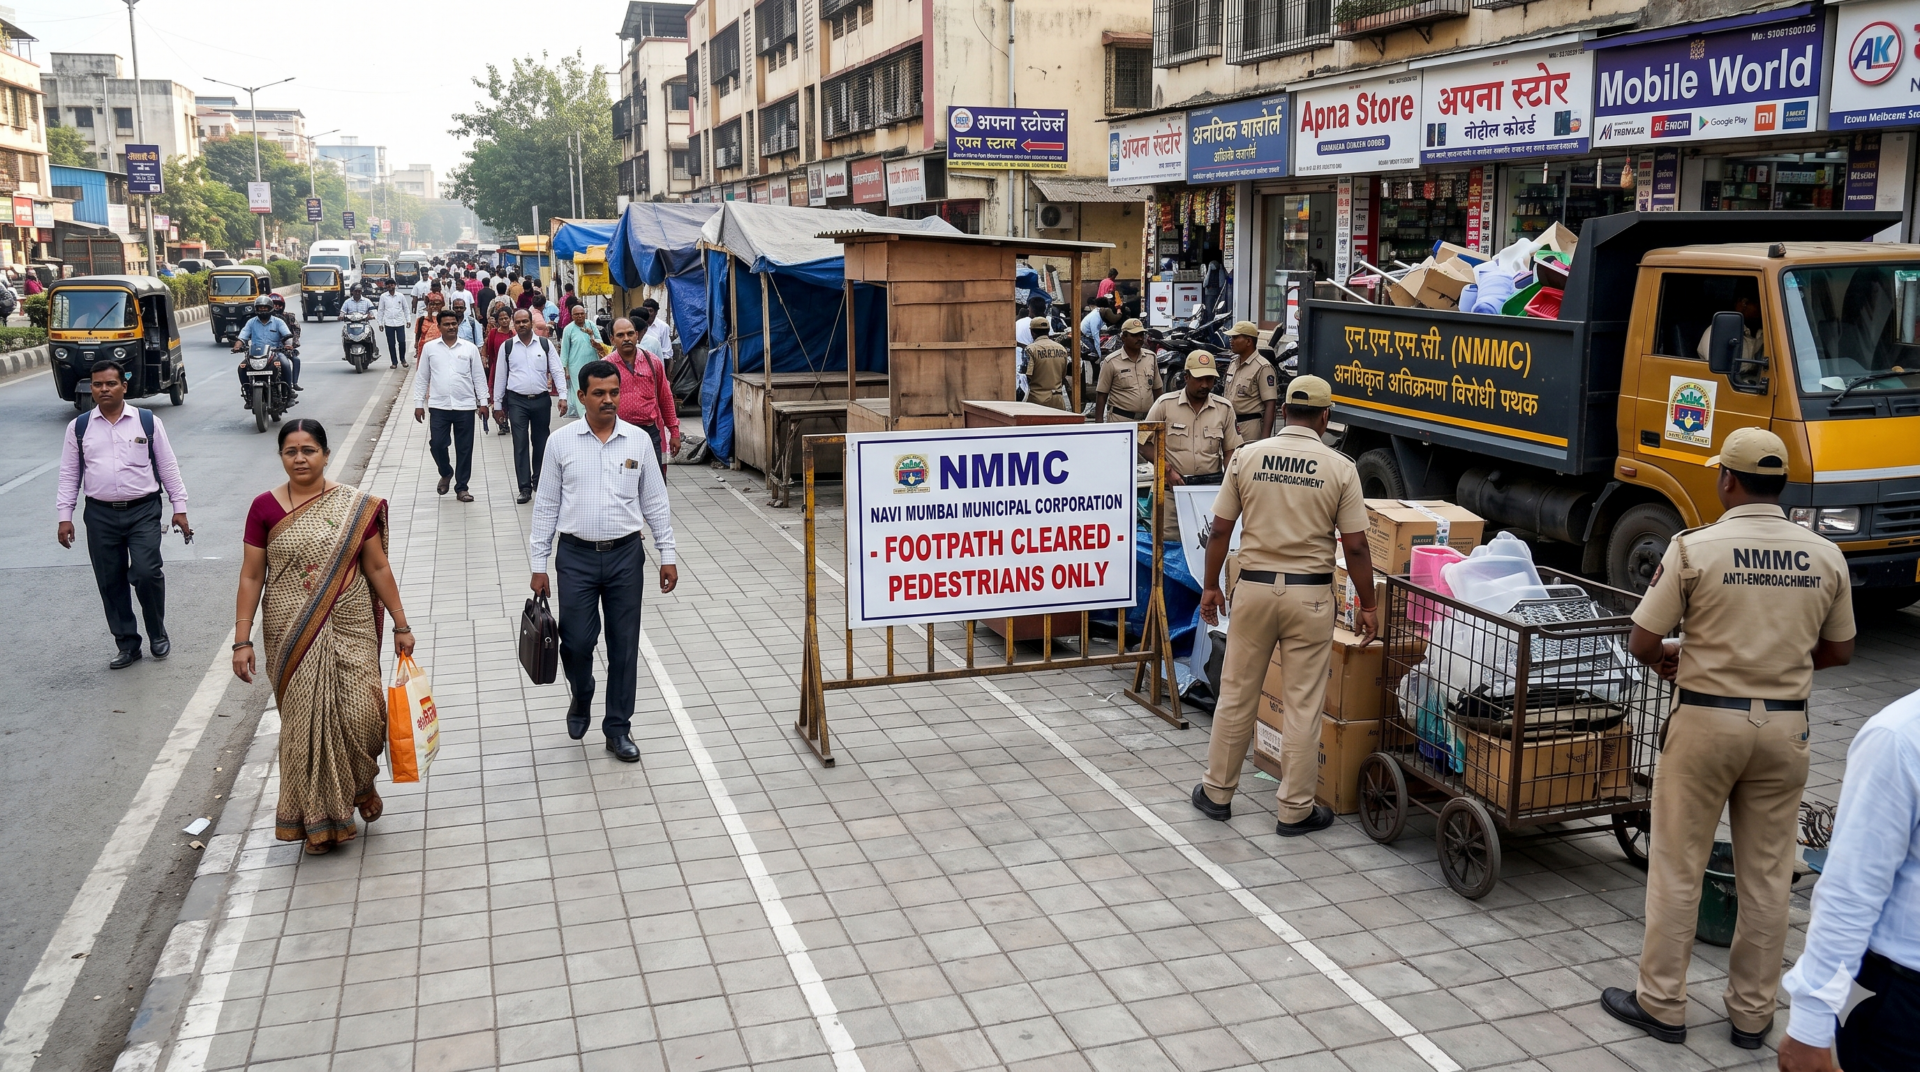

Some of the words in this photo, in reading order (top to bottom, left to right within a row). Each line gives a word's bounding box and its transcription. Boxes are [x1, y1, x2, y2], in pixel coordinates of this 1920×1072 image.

[1853, 34, 1896, 70] AK
[1438, 81, 1504, 116] अपना
[1511, 62, 1570, 109] स्टोर
[1599, 62, 1698, 108] Mobile
[1708, 45, 1814, 96] World
[1300, 101, 1349, 138] Apna
[1356, 92, 1414, 126] Store
[1710, 118, 1733, 126] Google
[1734, 116, 1748, 125] Play
[1344, 326, 1445, 360] एन.एम.एम.सी.
[1451, 335, 1532, 378] (NMMC)
[1388, 368, 1448, 402] अतिक्रमण
[1452, 375, 1496, 410] विरोधी
[1500, 389, 1539, 416] पथक
[939, 450, 1070, 490] NMMC
[1252, 472, 1324, 490] ANTI-ENCROACHMENT
[1262, 455, 1318, 475] NMMC
[870, 505, 902, 523] NAVI
[906, 503, 958, 522] MUMBAI
[962, 499, 1032, 518] MUNICIPAL
[1035, 494, 1123, 514] CORPORATION
[885, 530, 1003, 563] FOOTPATH
[1011, 523, 1111, 555] CLEARED
[1733, 548, 1811, 572] NMMC
[889, 565, 1045, 602] PEDESTRIANS
[1051, 561, 1110, 590] ONLY
[1722, 572, 1821, 588] ANTI-ENCROACHMENT
